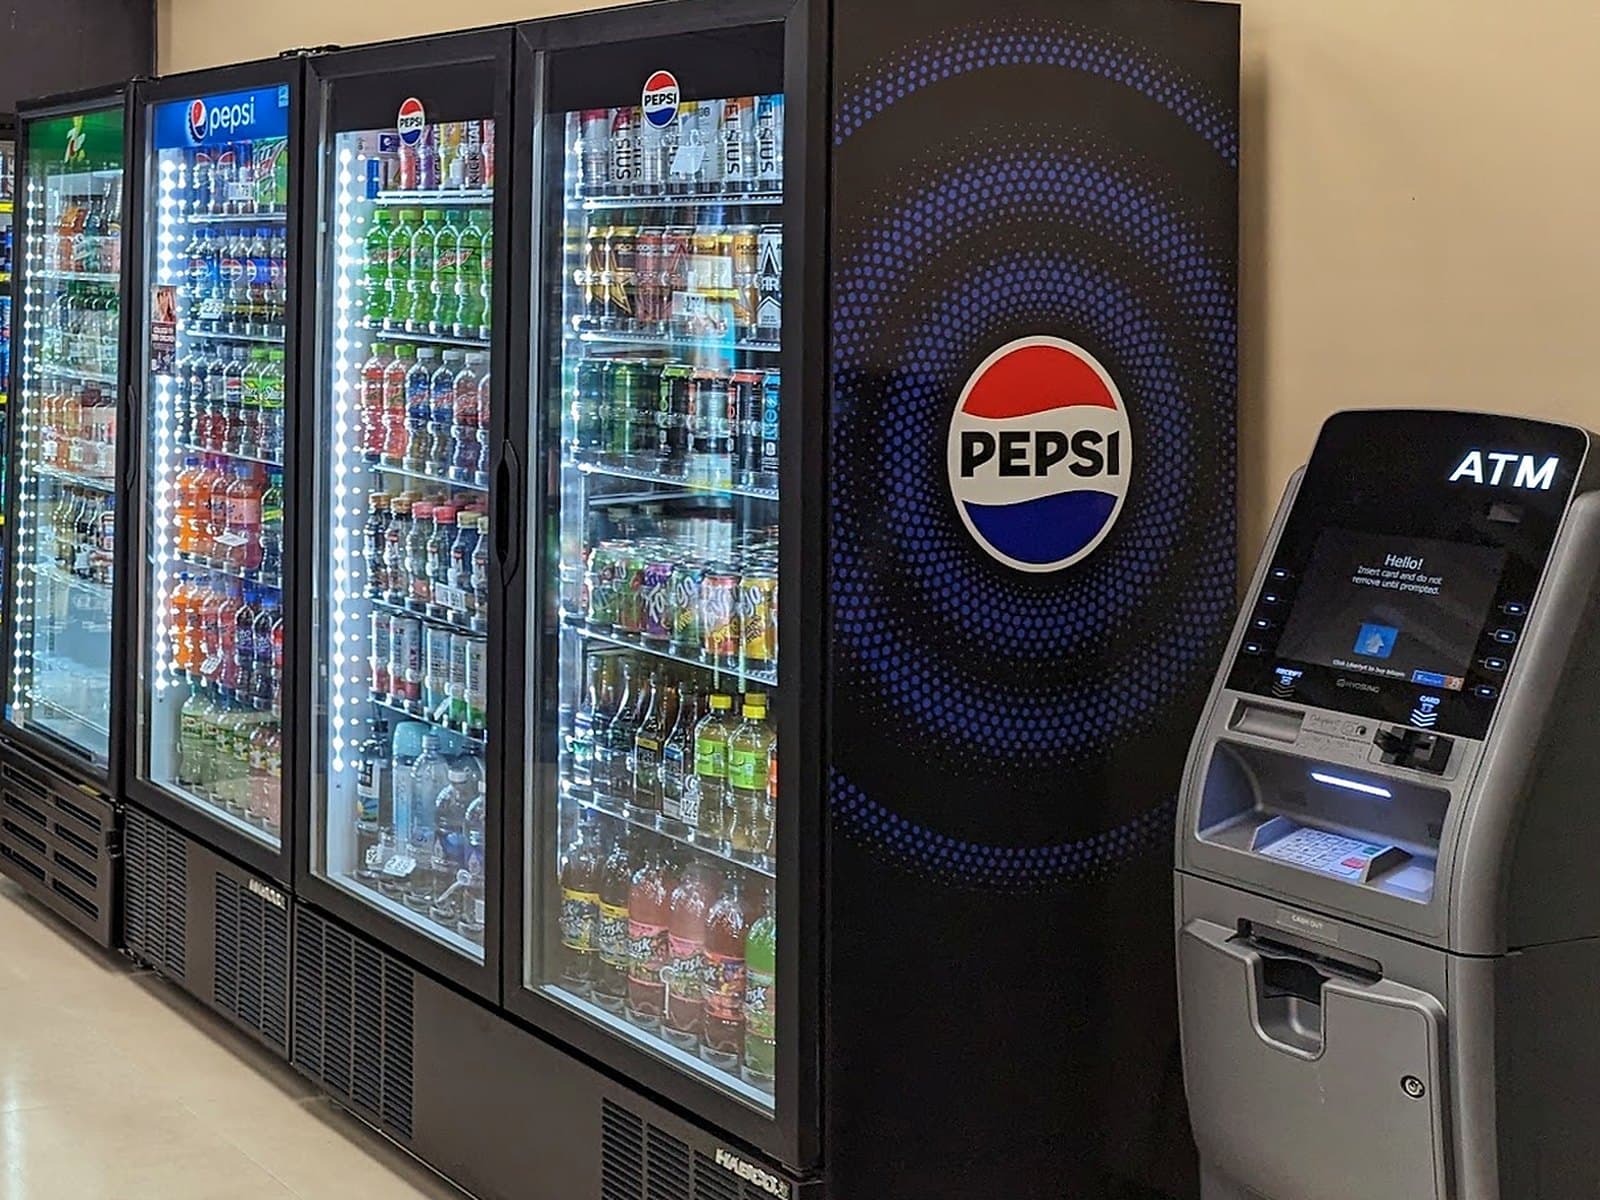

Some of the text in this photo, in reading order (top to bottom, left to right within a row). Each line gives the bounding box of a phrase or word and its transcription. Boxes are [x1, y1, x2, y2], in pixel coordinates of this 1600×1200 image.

[644, 93, 677, 107] PEPSI
[209, 96, 255, 136] pepsi
[399, 116, 423, 129] PEPSI
[468, 119, 481, 186] KICKSTAR
[960, 429, 1120, 478] PEPSI
[1448, 450, 1560, 490] ATM
[1384, 553, 1424, 570] Hello!
[1357, 565, 1443, 585] Insert card and do not
[1352, 576, 1440, 595] remove until prompted.
[1275, 667, 1303, 678] RECEIPT
[1419, 695, 1440, 705] CARD
[715, 1148, 779, 1194] HABCO
